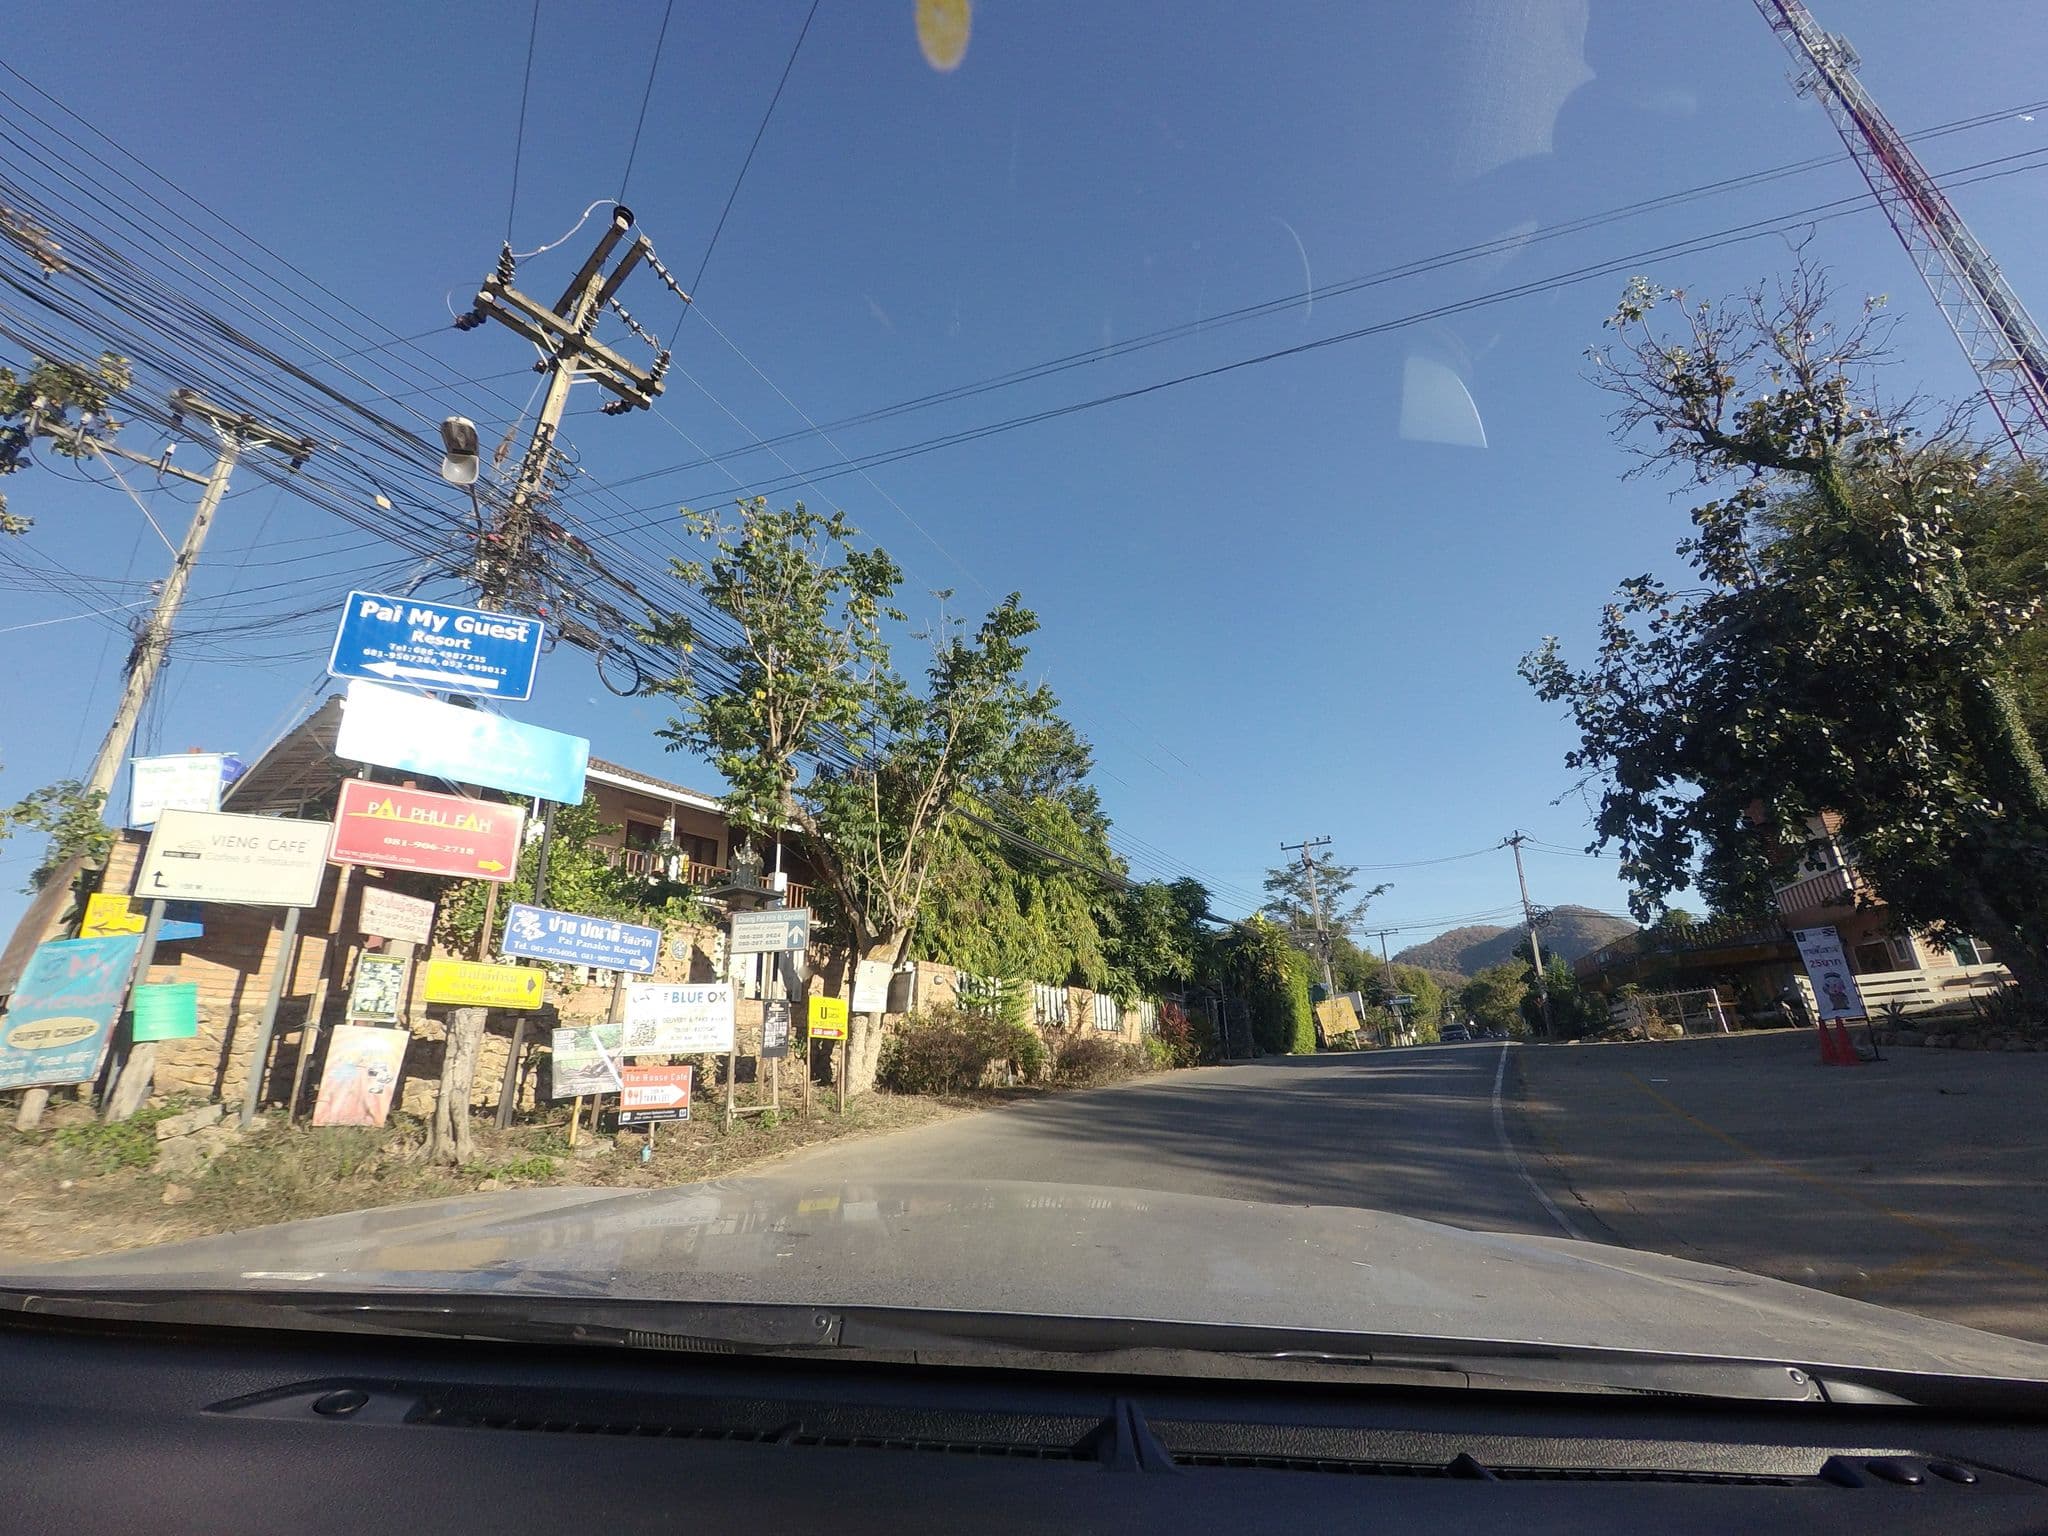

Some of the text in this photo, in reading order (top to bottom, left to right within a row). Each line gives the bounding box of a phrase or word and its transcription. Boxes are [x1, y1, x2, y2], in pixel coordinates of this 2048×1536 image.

[360, 600, 403, 623] Pai
[408, 608, 449, 632] My
[454, 615, 531, 642] Guest
[411, 630, 472, 649] Resort
[367, 798, 493, 833] PAI PHU FAH
[212, 835, 259, 850] VIENG
[548, 917, 576, 935] ปาย
[558, 937, 642, 956] Pai Panalee Resort
[672, 992, 704, 1003] BLUE
[707, 992, 727, 1003] OX
[13, 1025, 95, 1042] SUPER CHEAP
[626, 1073, 641, 1081] The
[642, 1073, 668, 1081] House
